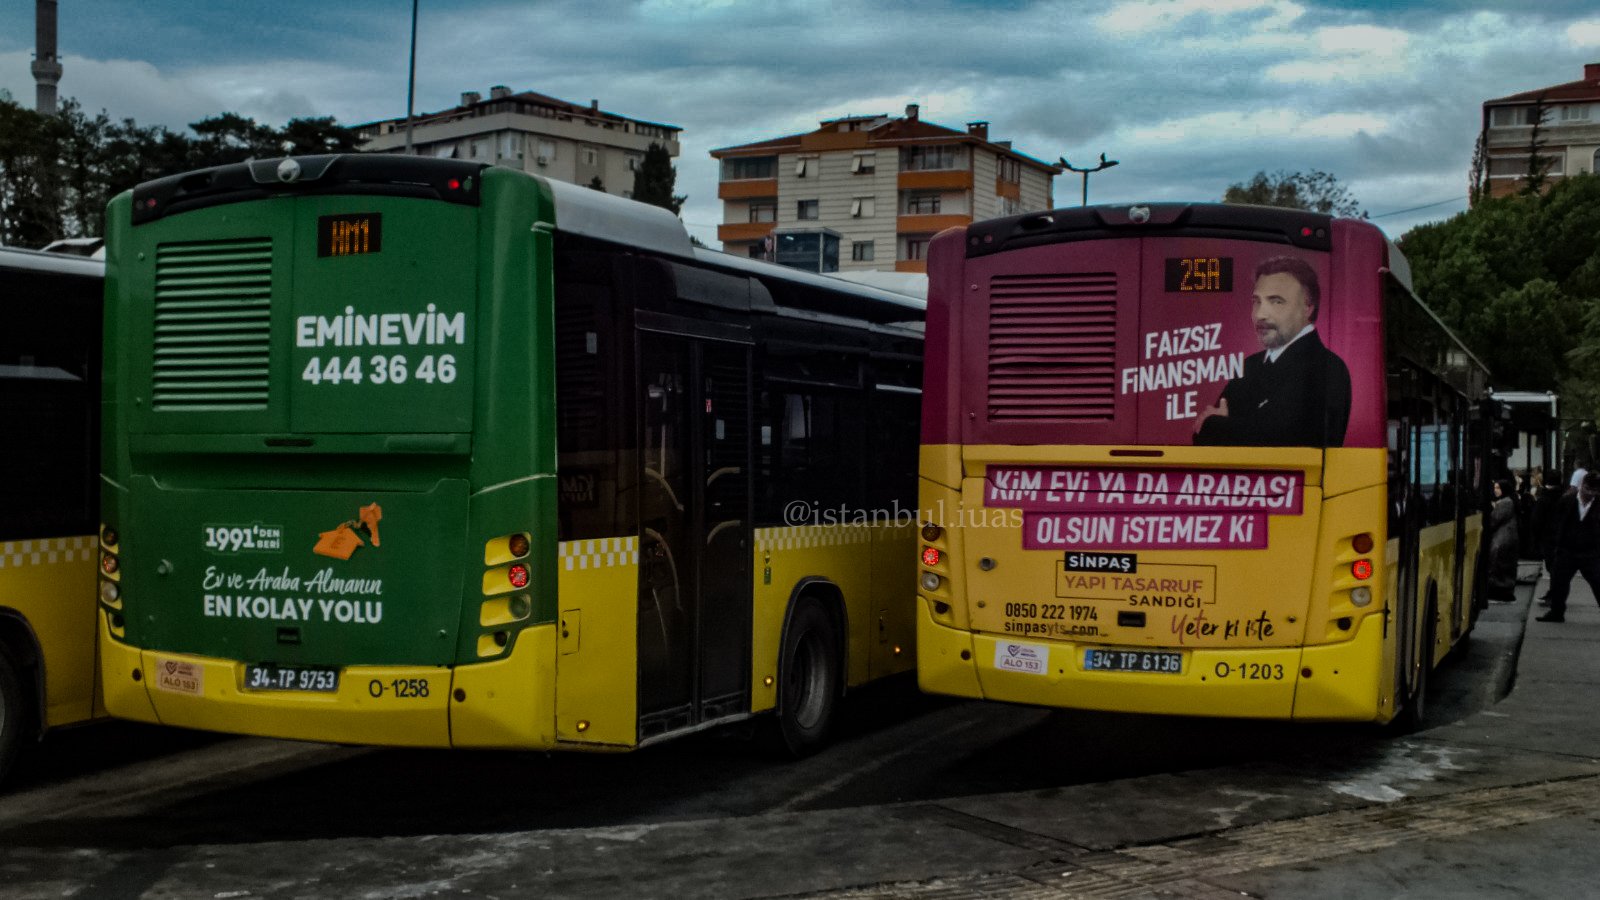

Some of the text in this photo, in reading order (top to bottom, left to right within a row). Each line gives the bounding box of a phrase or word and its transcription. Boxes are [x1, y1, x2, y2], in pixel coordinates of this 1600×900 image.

[331, 219, 370, 257] HM1
[1180, 258, 1221, 290] 25A
[296, 302, 465, 348] EMİNEVİM
[1144, 322, 1222, 360] FAİZSİZ
[302, 354, 457, 386] 444 36 46
[1121, 352, 1245, 396] FİNANSMAN
[1165, 391, 1198, 421] İLE
[991, 470, 1296, 508] KİM EVİ YA DA ARABASI
[1036, 515, 1254, 544] OLSUN İSTEMEZ Kİ
[1068, 553, 1131, 572] SİNPAŞ
[202, 565, 383, 595] Ev ve Araba Almanın
[1064, 575, 1203, 593] YAPI TASARRUF
[203, 594, 383, 624] EN KOLAY YOLU
[1005, 602, 1098, 621] 0850 222 1974
[1129, 594, 1201, 608] SANDIĞI
[1171, 609, 1219, 645] Yeter
[1025, 661, 1039, 670] 153
[1093, 652, 1179, 671] 34 TP 6136
[1215, 661, 1284, 680] O-1203
[278, 669, 295, 688] TP
[300, 670, 335, 689] 9753
[368, 678, 430, 699] O-1258
